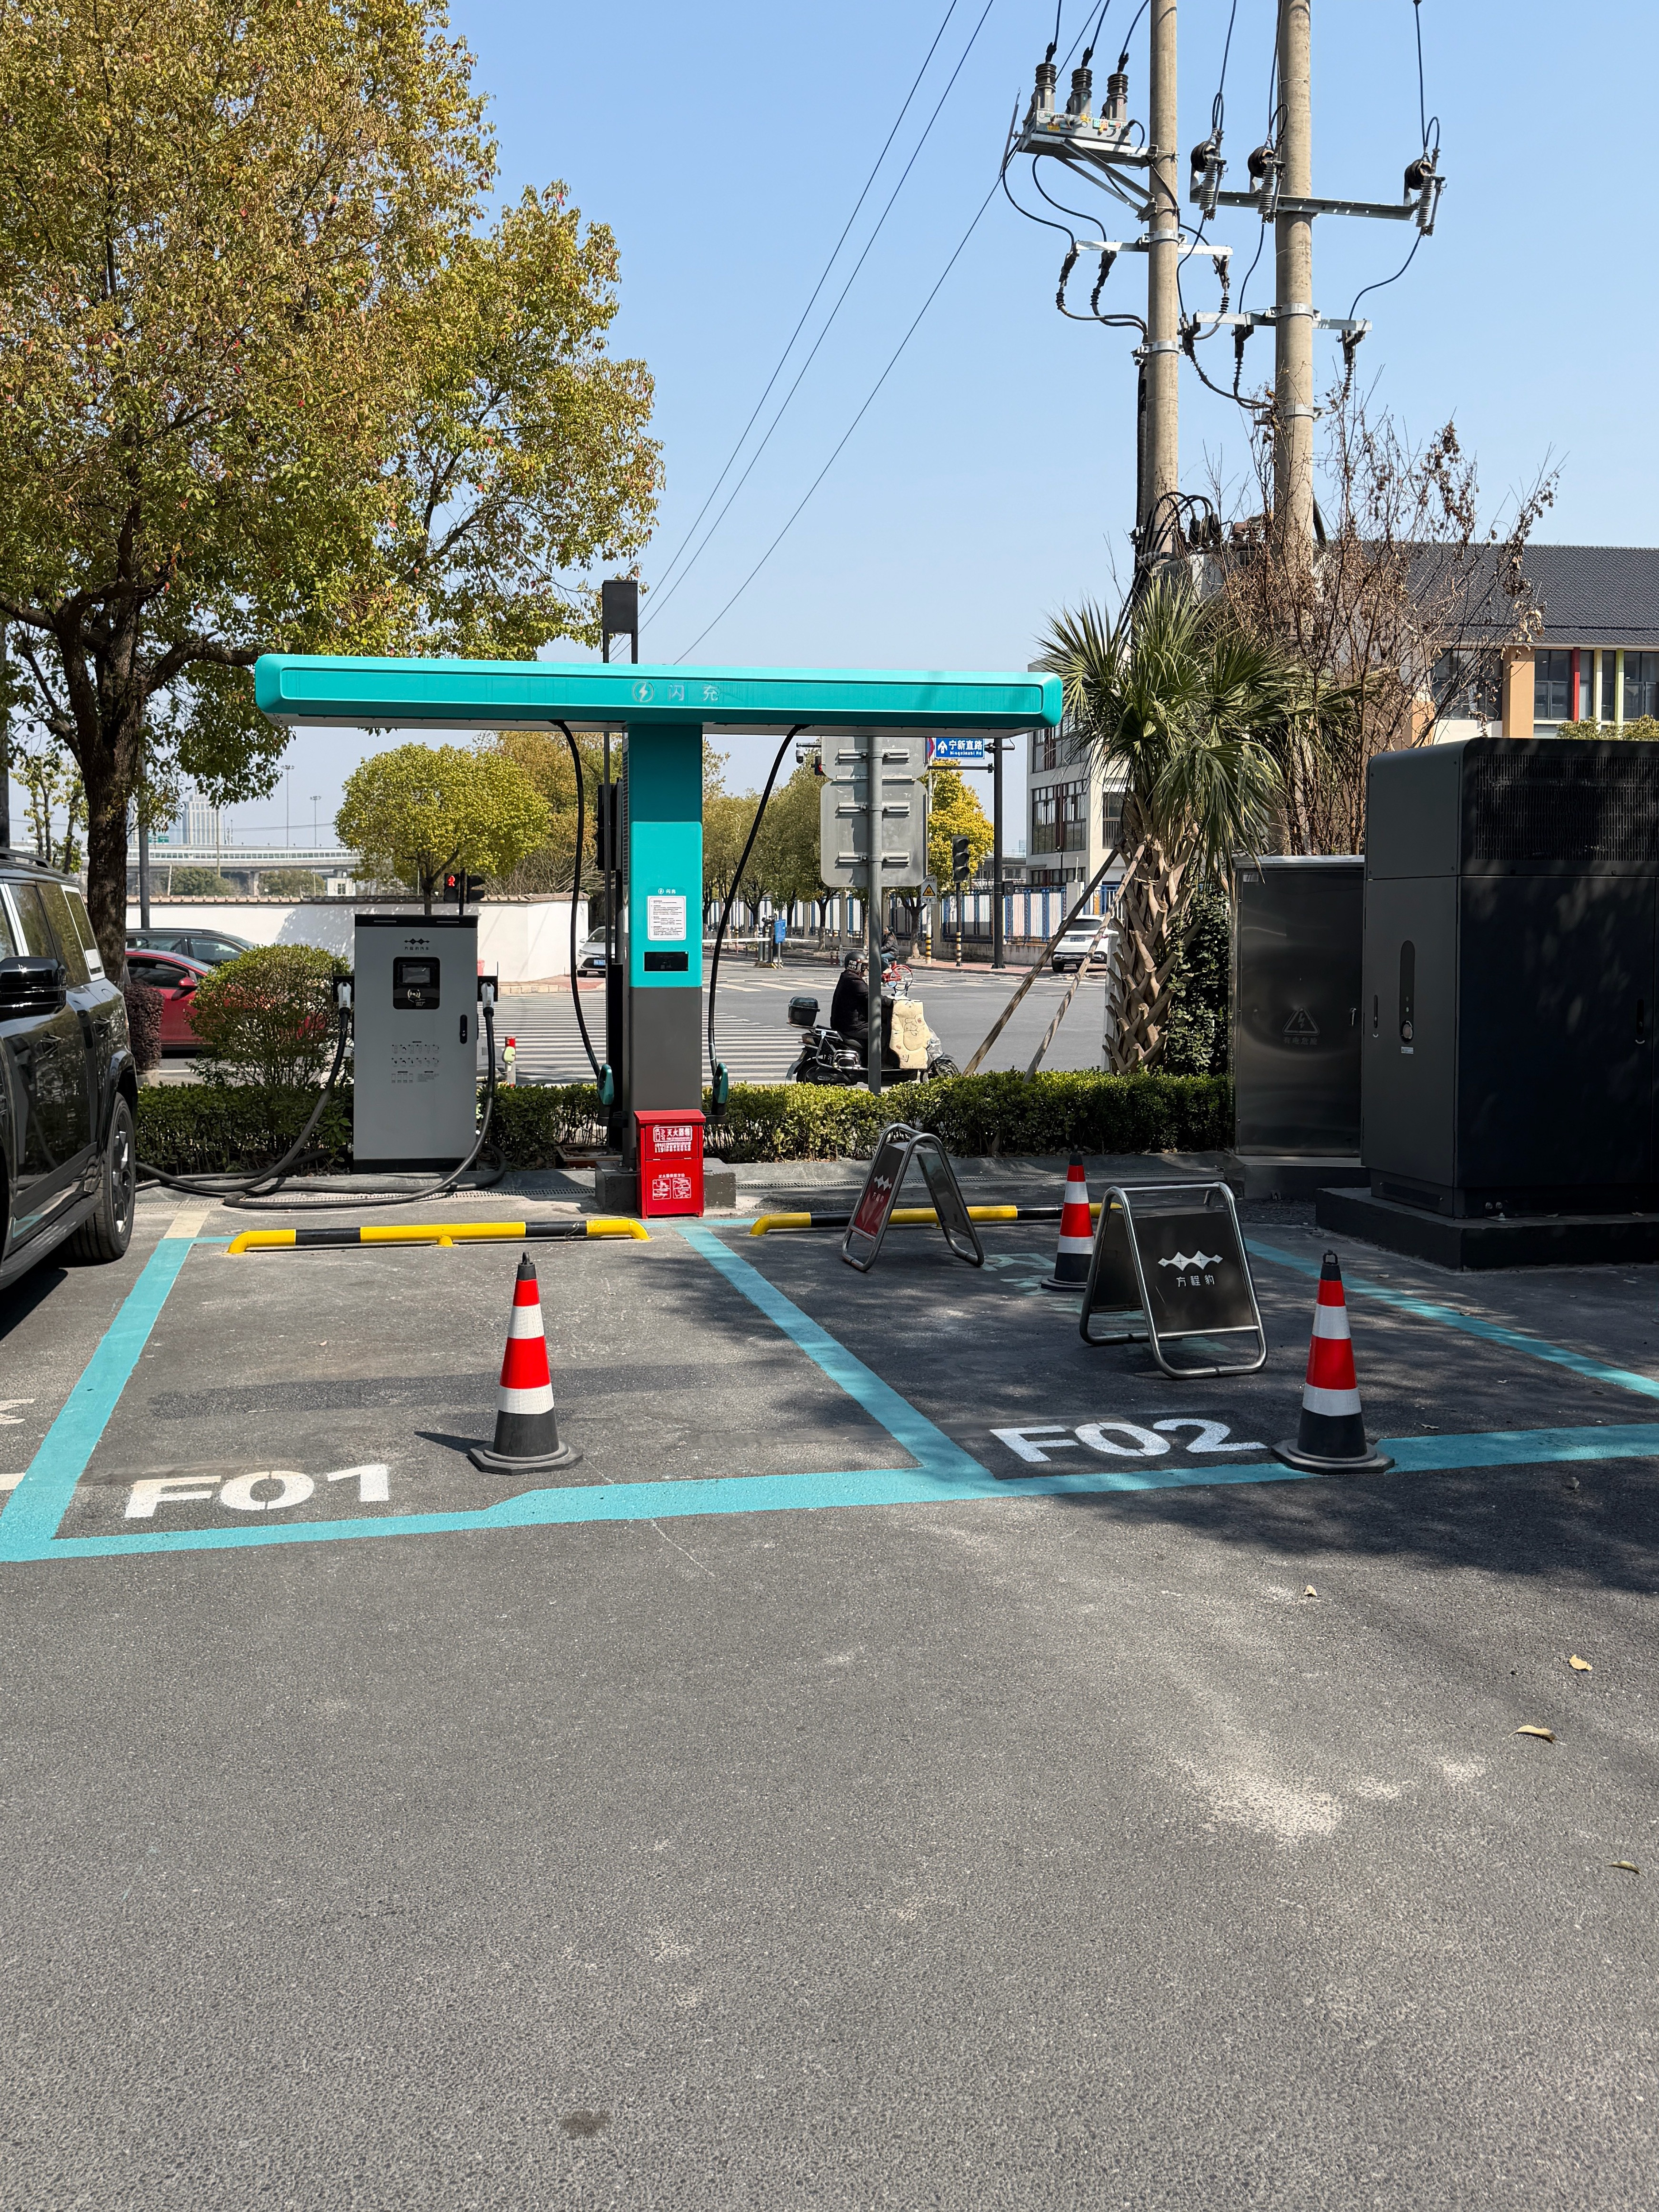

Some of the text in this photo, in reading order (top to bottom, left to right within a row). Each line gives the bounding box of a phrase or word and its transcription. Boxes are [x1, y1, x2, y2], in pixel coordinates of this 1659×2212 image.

[669, 683, 720, 701] 闪充
[949, 740, 982, 750] 宁新直路
[1176, 1274, 1215, 1287] 方程豹
[989, 1418, 1268, 1462] F02
[124, 1464, 390, 1518] F01
